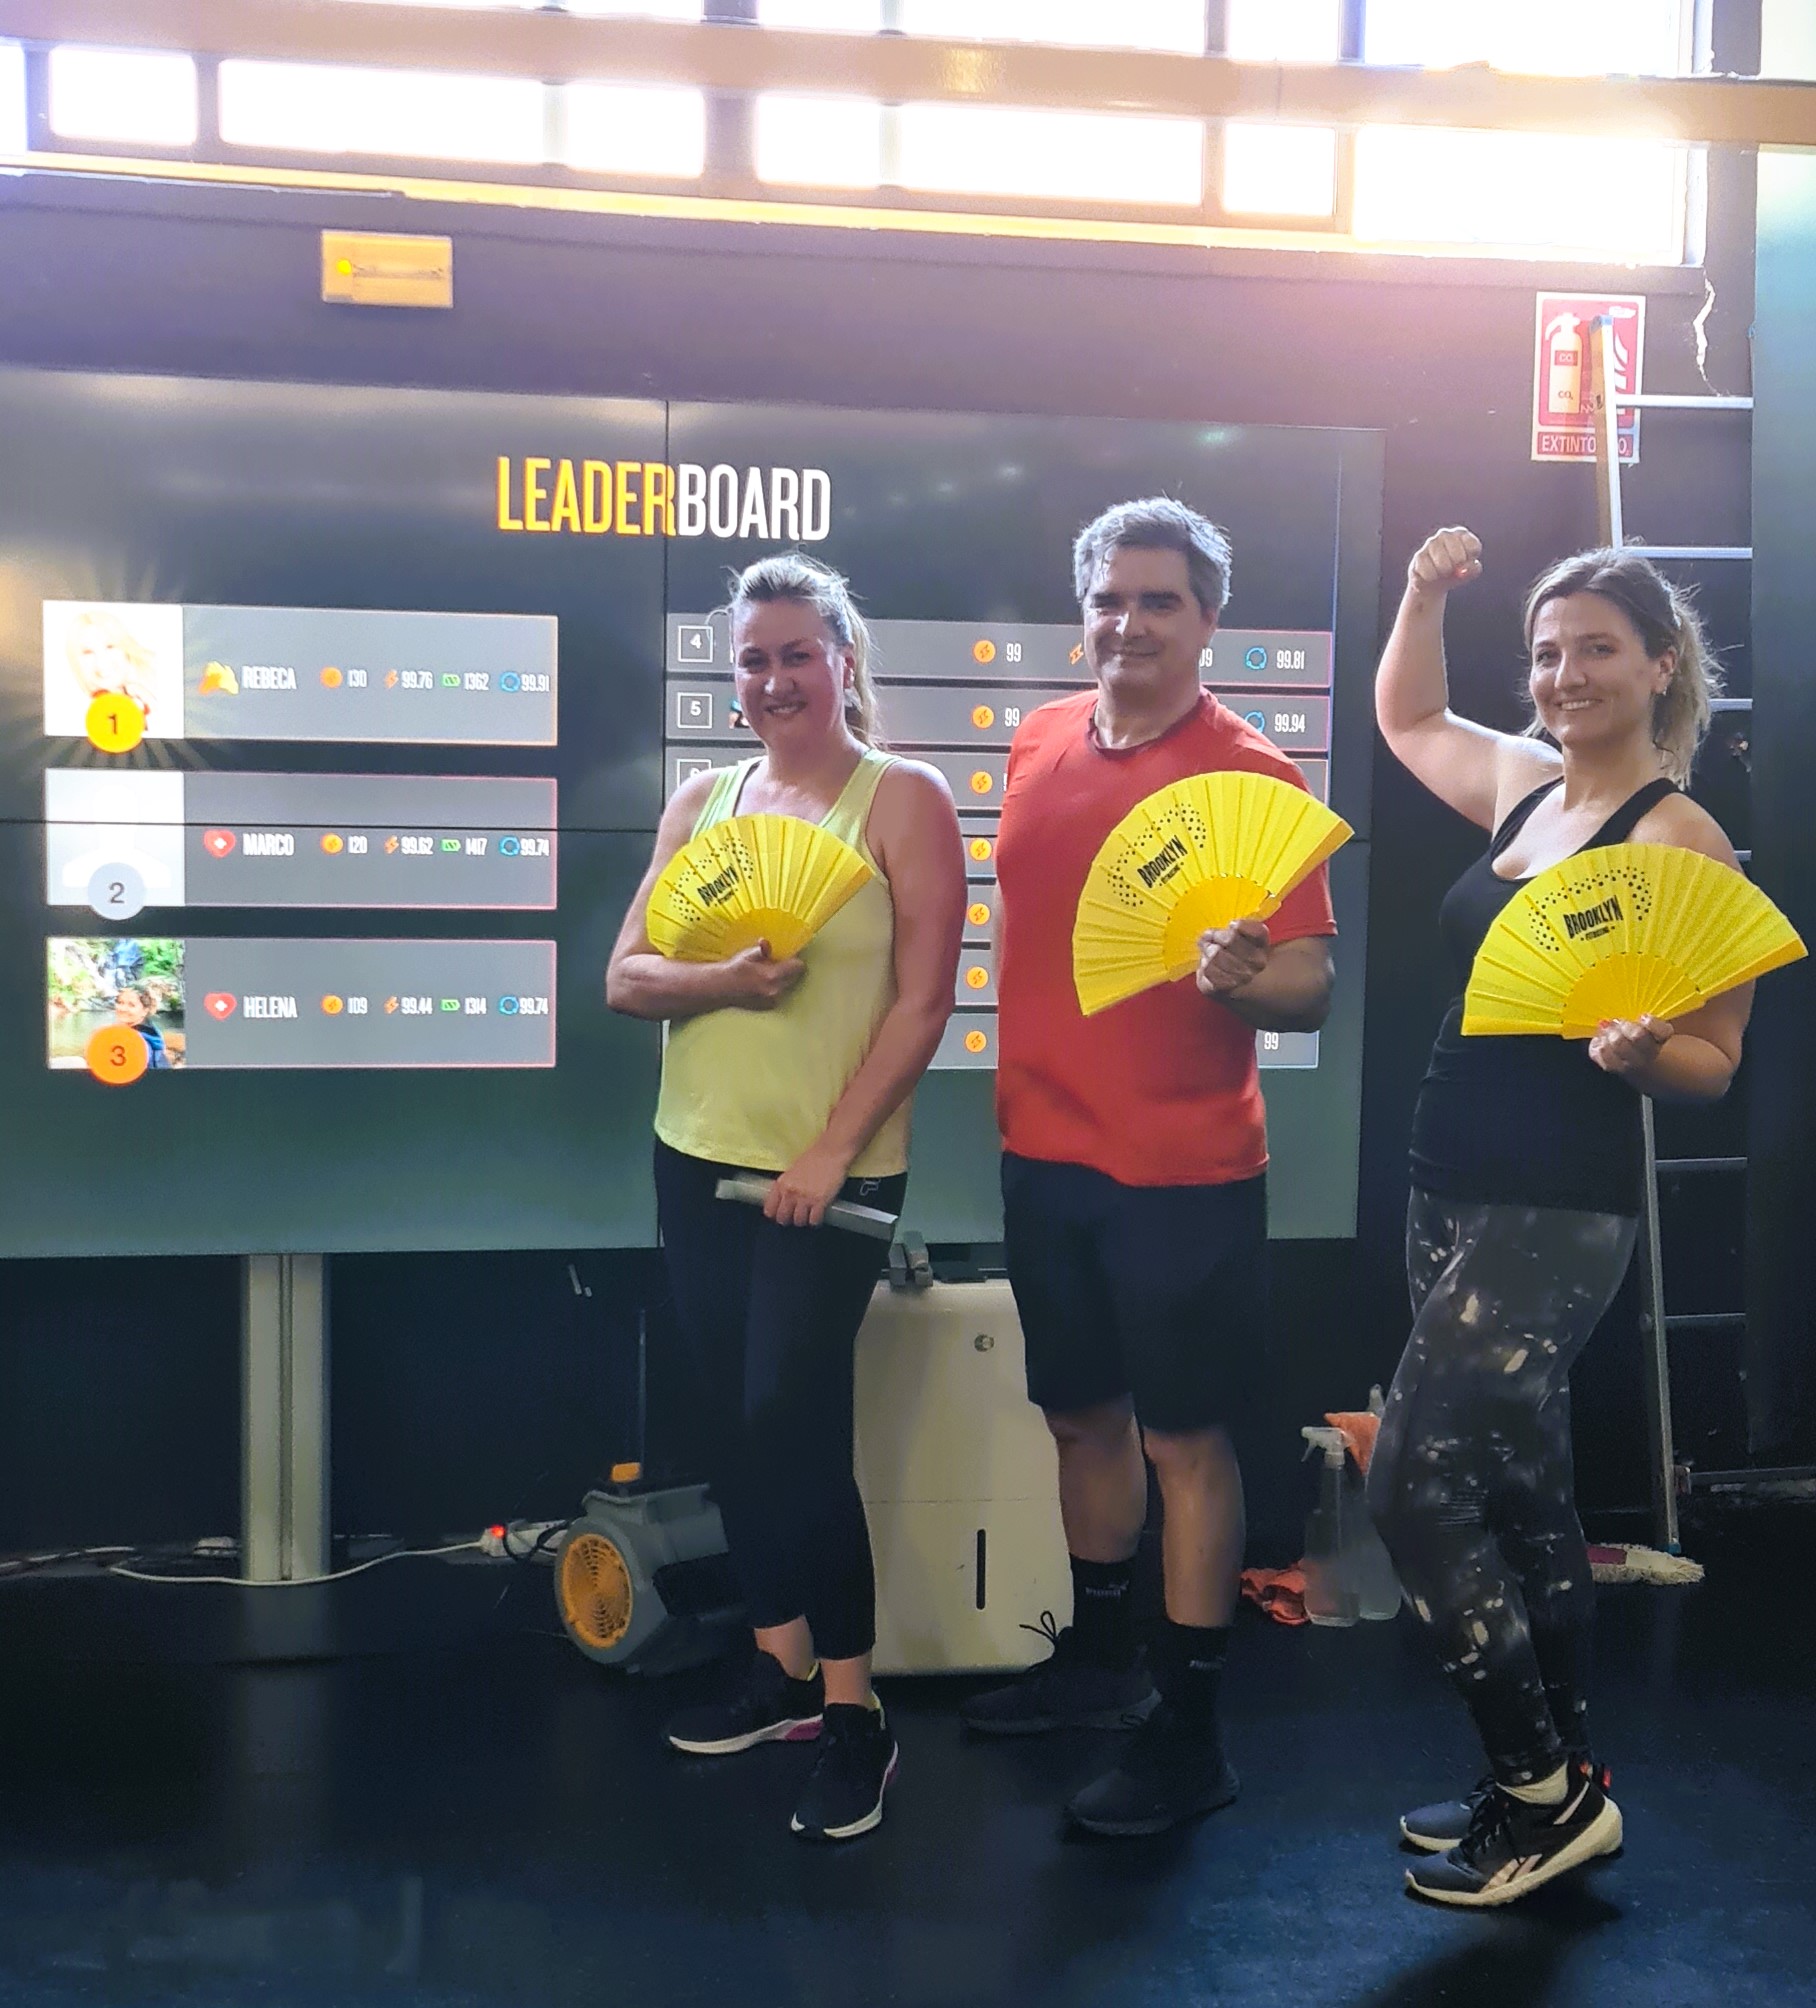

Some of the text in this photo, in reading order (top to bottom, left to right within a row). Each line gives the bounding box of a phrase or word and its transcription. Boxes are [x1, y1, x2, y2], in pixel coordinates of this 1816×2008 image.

[1541, 435, 1598, 453] EXTINTO
[497, 455, 832, 542] LEADERBOARD
[689, 633, 702, 649] 4
[1006, 643, 1022, 663] 99
[1276, 650, 1305, 670] 99.81
[242, 666, 297, 690] REBECA
[401, 671, 434, 689] 99.76
[464, 673, 489, 691] 1362
[520, 674, 550, 692] 99.91
[107, 713, 119, 735] 1
[690, 701, 1306, 733] 5 99 99.94
[242, 833, 550, 857] MARCO 120 99.62 1417 99.74
[1137, 834, 1188, 888] BROOKLYN
[108, 881, 126, 904] 2
[1563, 894, 1624, 939] BROOKLYN
[243, 995, 298, 1018] HELENA
[348, 997, 368, 1014] 109
[401, 997, 433, 1015] 99.44
[518, 997, 549, 1015] 99.74
[1264, 1032, 1279, 1050] 99
[110, 1044, 127, 1067] 3
